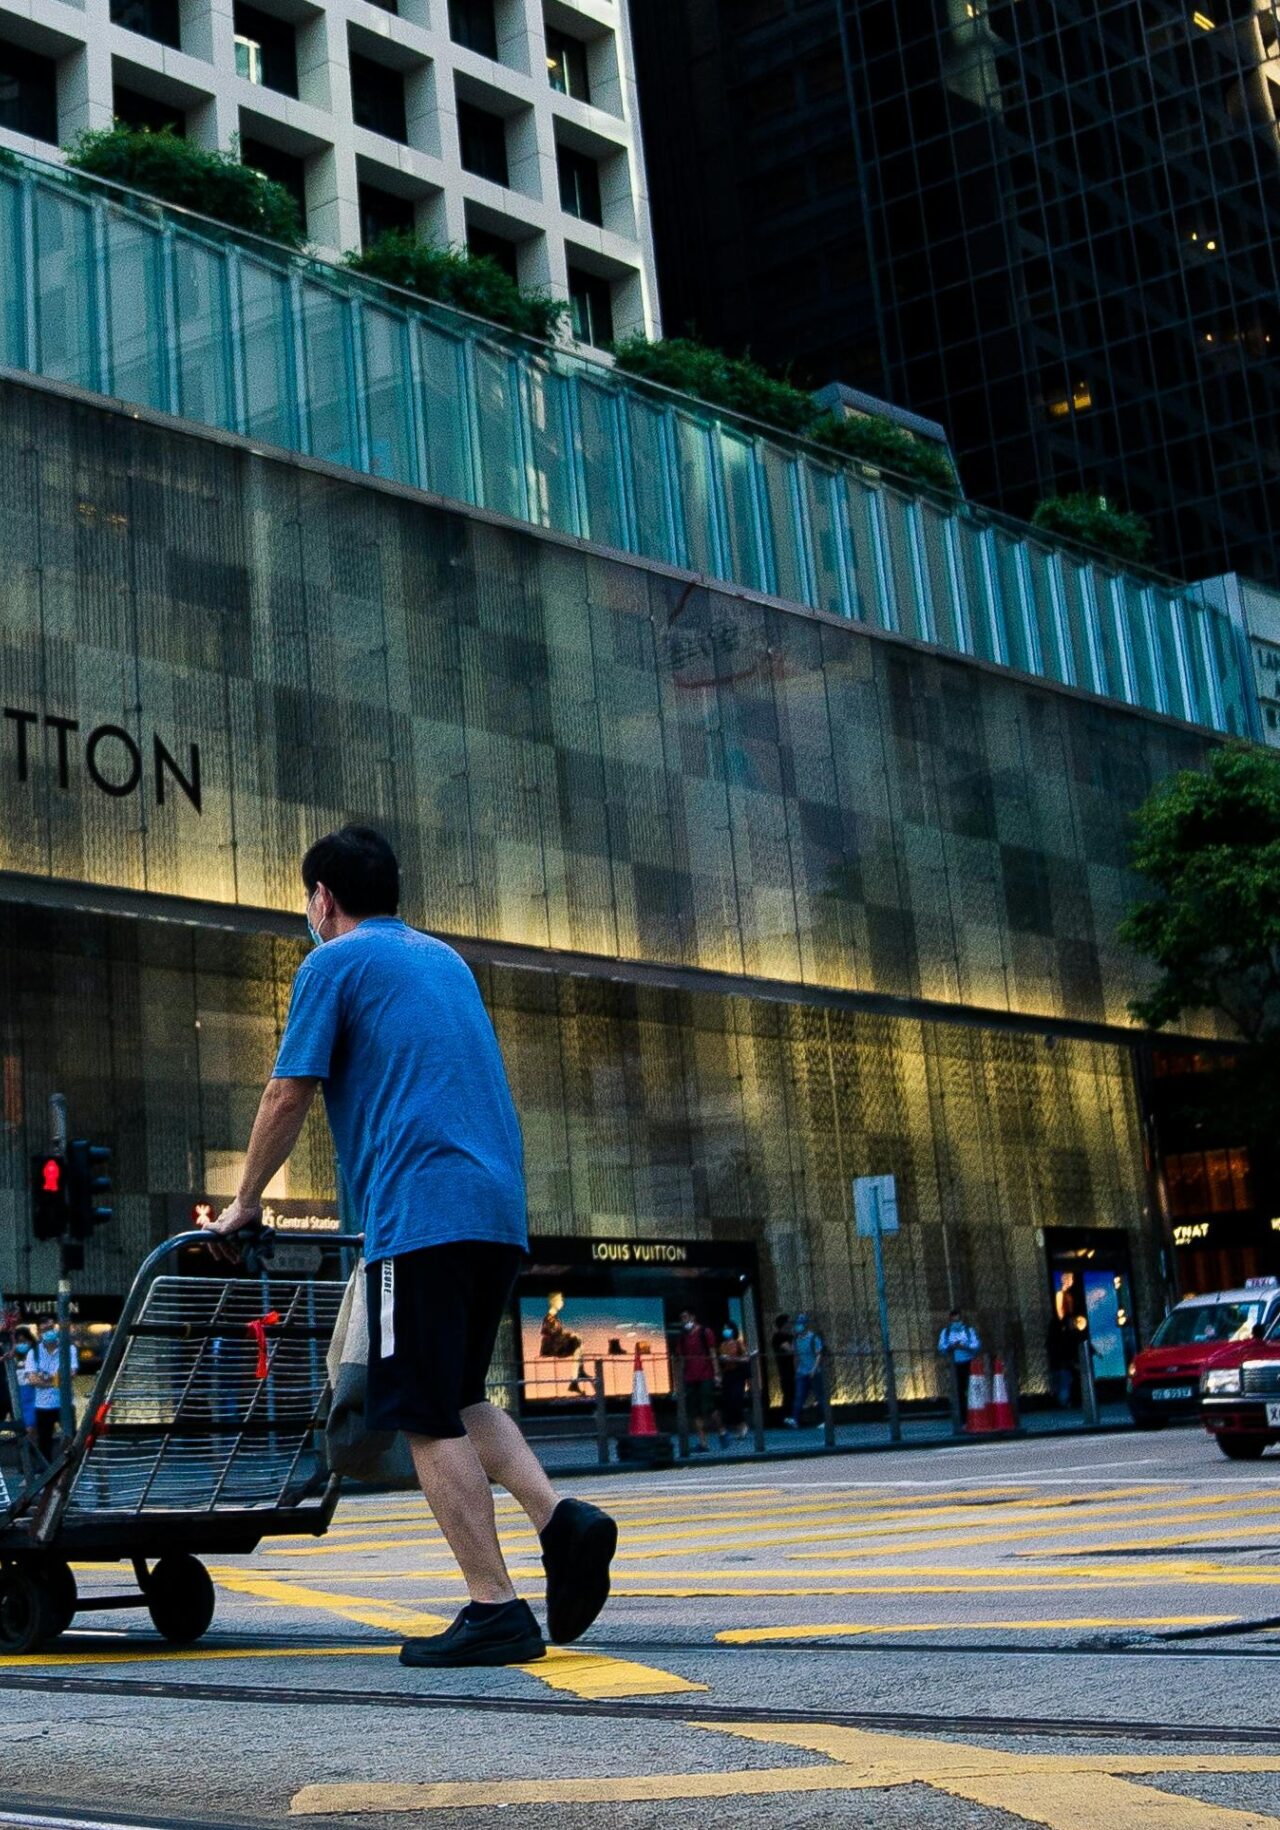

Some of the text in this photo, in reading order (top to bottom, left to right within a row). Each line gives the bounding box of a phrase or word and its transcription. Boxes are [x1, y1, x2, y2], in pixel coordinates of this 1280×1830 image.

[276, 1215, 309, 1229] Central
[592, 1243, 687, 1261] LOUIS VUITTON
[24, 1300, 80, 1315] VUITTN
